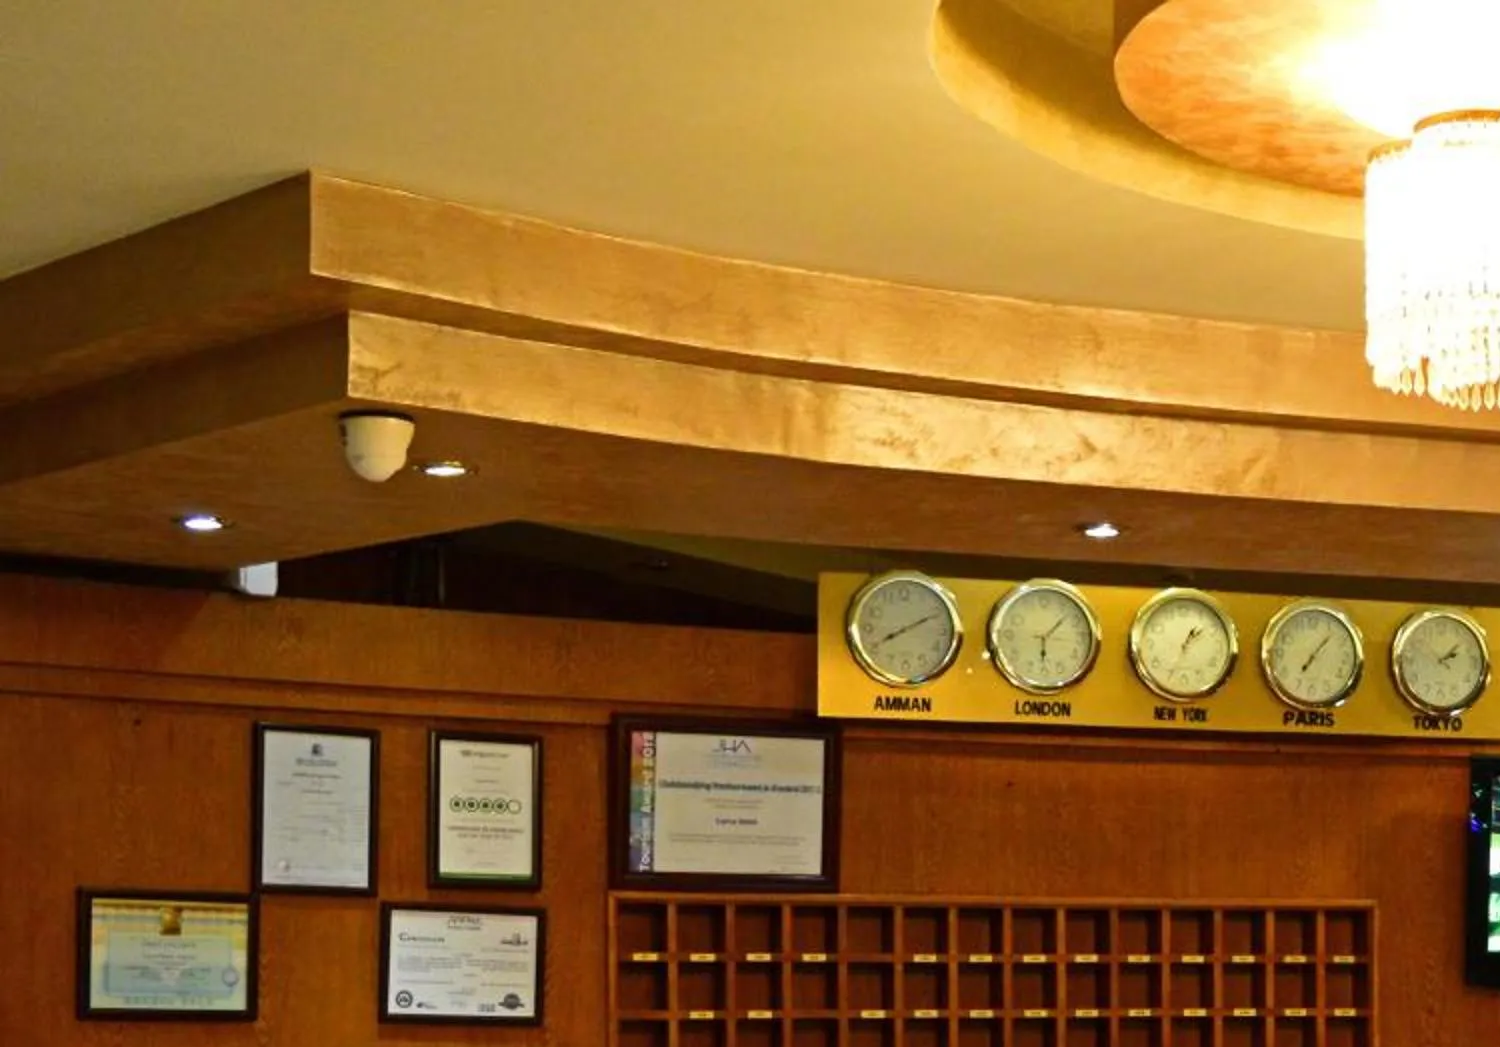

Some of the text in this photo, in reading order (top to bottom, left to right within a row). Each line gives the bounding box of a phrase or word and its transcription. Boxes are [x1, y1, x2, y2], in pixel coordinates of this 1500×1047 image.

[874, 694, 932, 713] AMMAN
[1014, 700, 1071, 717] LONDON
[1153, 706, 1208, 722] NEW YORK
[1282, 710, 1335, 727] PARIS
[1413, 715, 1463, 731] TOKYO
